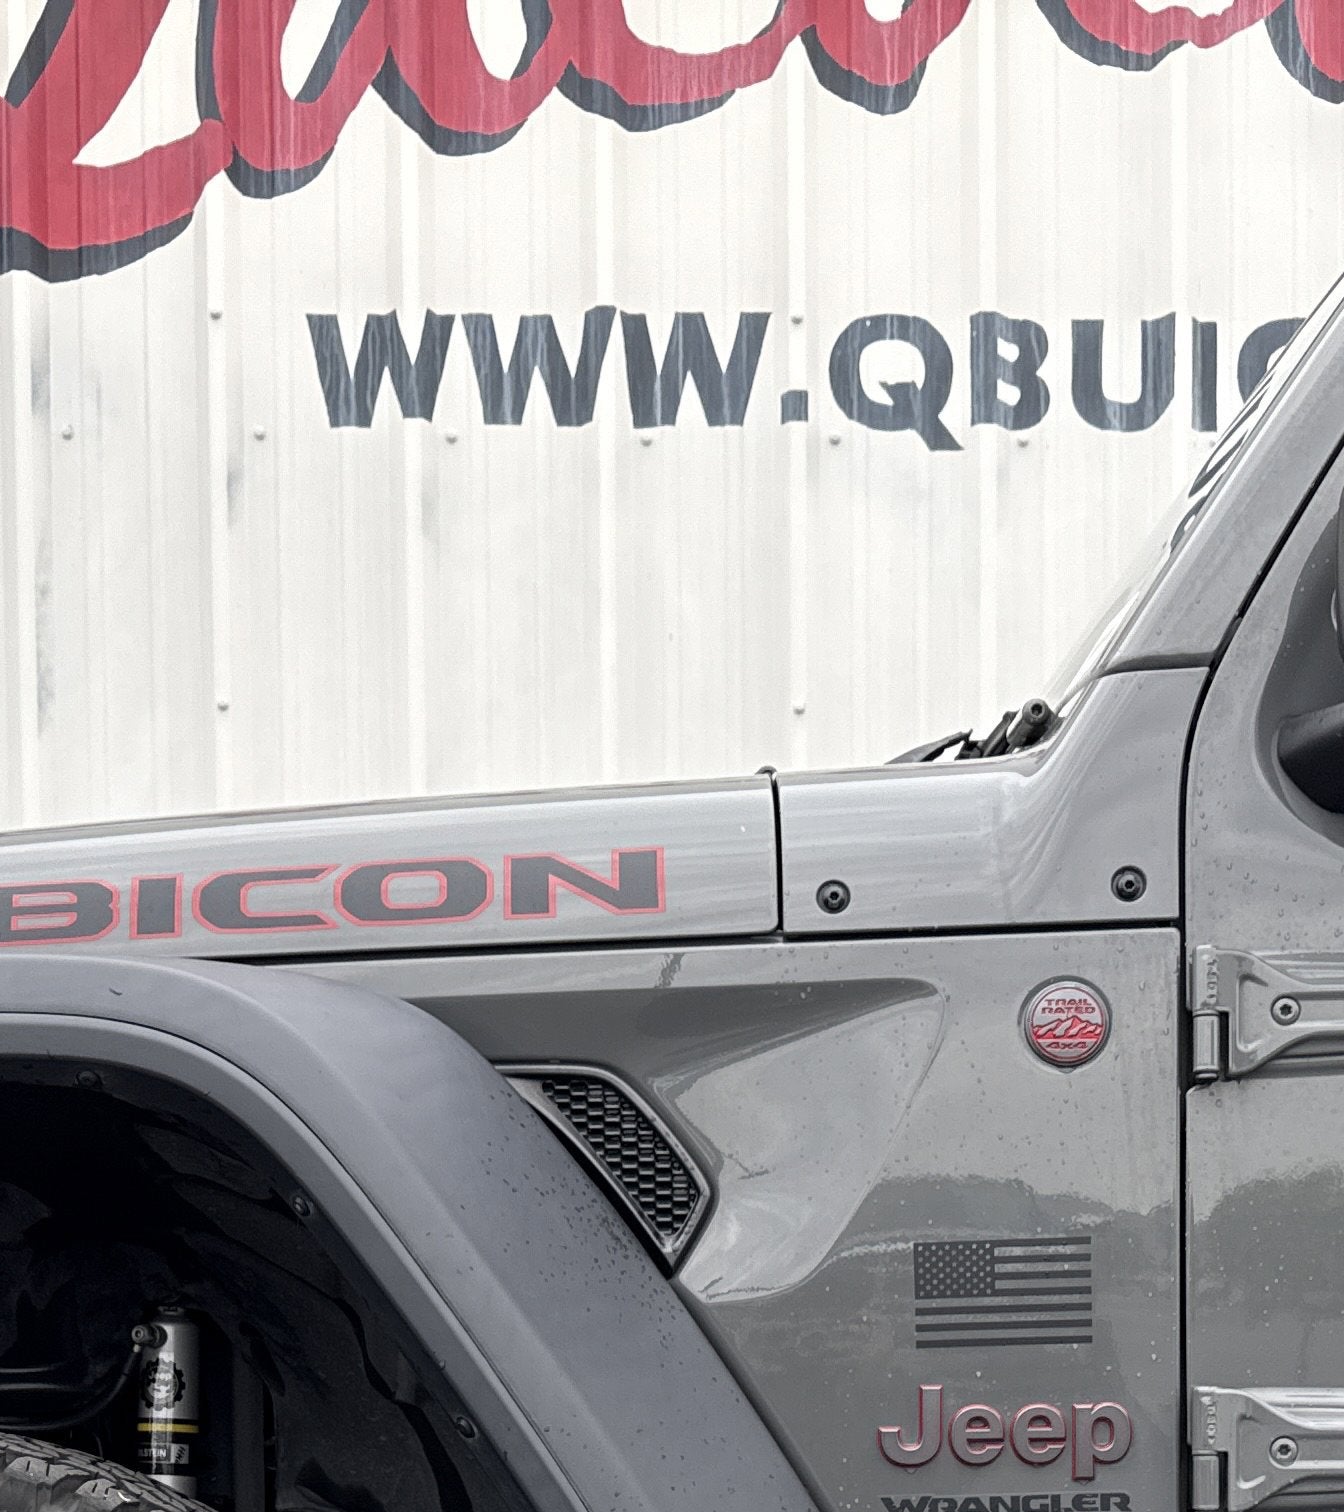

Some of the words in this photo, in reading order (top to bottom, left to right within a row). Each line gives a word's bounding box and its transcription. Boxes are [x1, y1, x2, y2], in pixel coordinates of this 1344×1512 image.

[1045, 998, 1092, 1006] TRAIL
[1041, 1006, 1096, 1014] RATED
[877, 1384, 1133, 1482] Jeep
